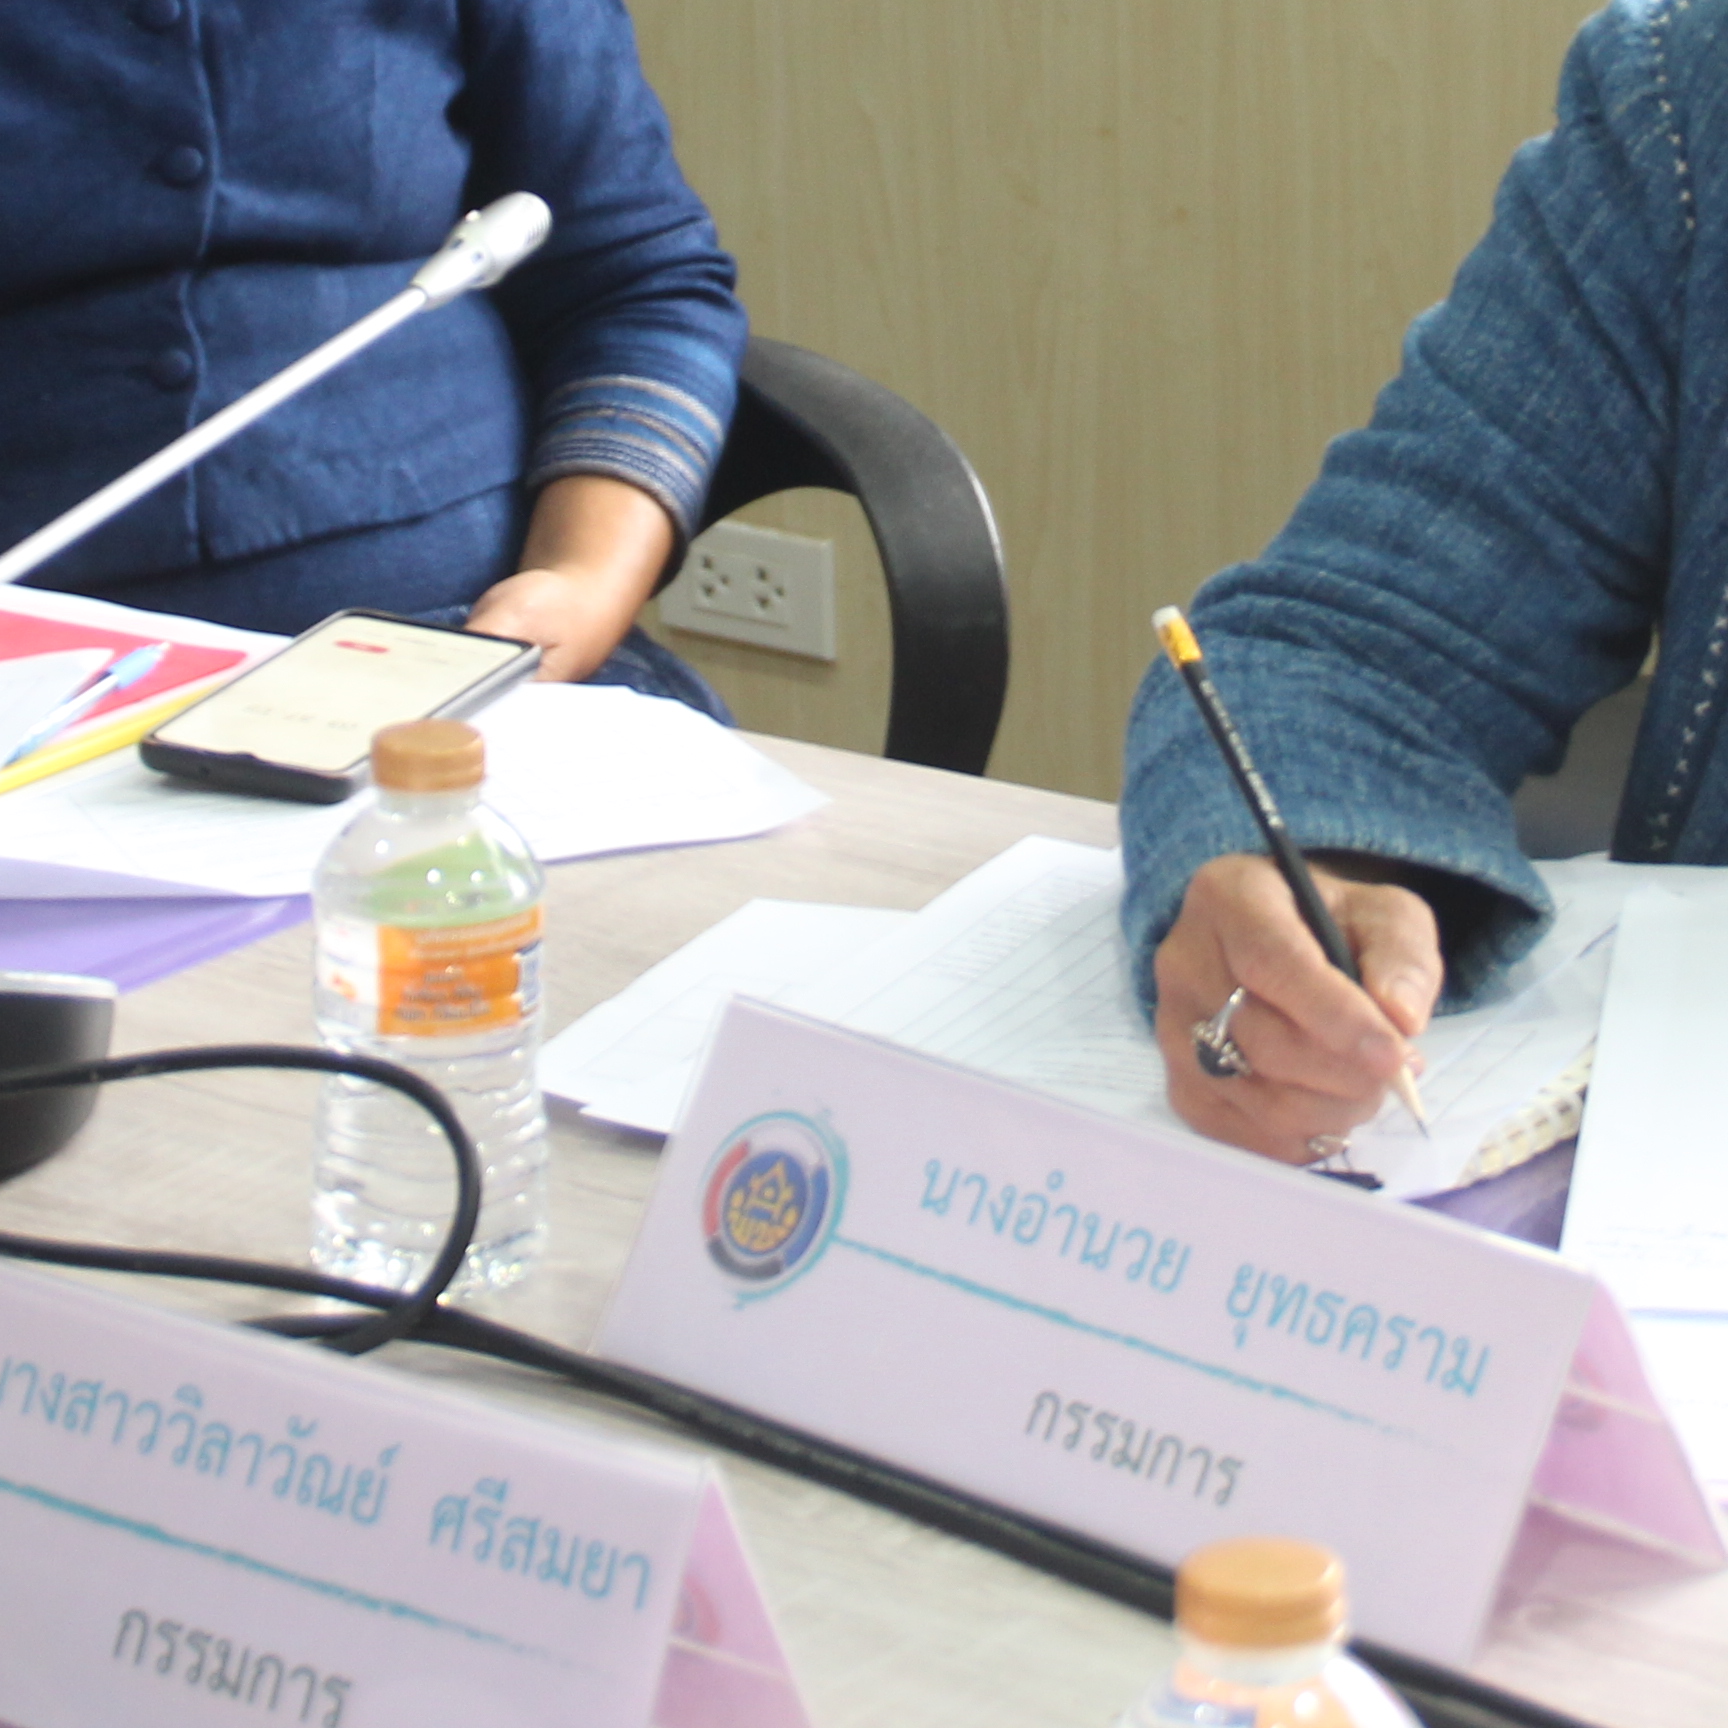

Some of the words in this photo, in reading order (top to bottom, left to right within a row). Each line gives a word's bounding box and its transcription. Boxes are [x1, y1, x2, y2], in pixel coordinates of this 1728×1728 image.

[919, 1157, 1192, 1294] นางอำนวย
[1225, 1262, 1491, 1398] ยุทธคราม
[1025, 1390, 1246, 1507] กรรมการ
[428, 1475, 653, 1612] ศรีสมยา
[111, 1607, 353, 1728] กรรมการ
